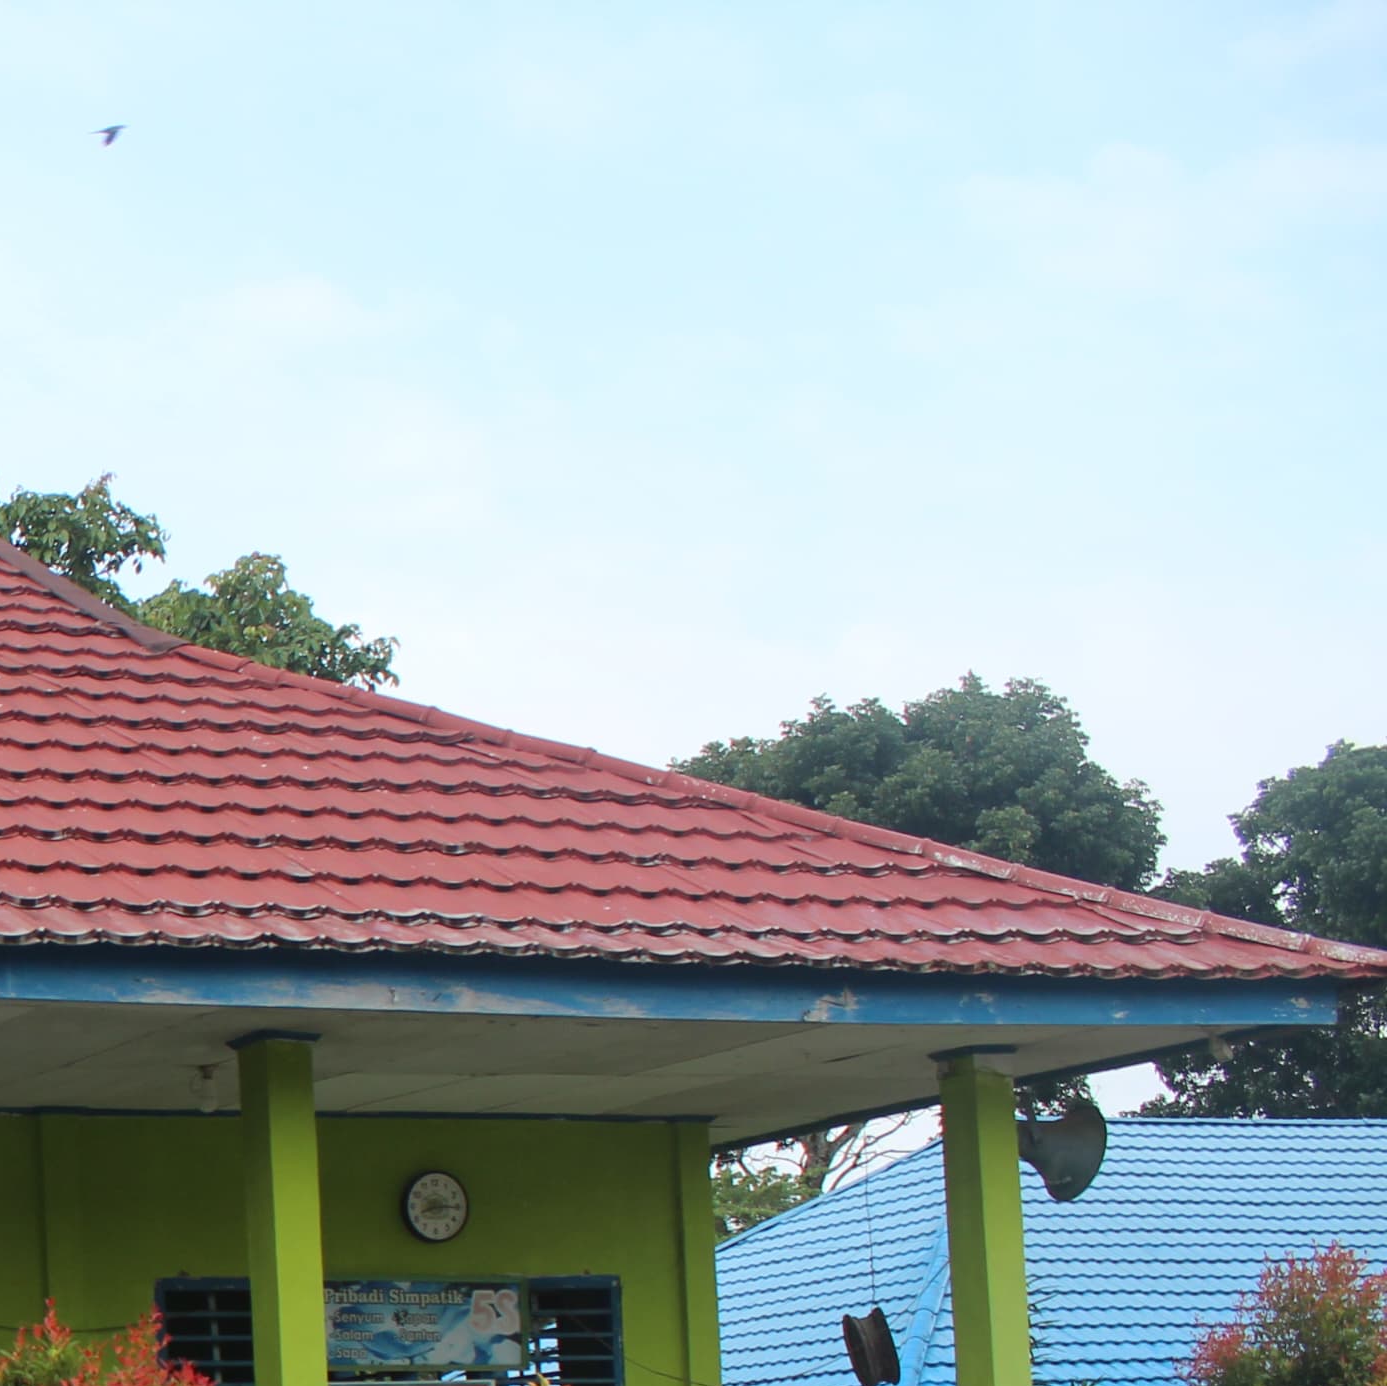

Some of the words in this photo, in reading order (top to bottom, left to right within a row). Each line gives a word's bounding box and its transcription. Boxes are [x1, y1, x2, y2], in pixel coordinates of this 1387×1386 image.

[324, 1288, 385, 1305] Pribadi
[388, 1288, 464, 1308] Simpatik
[471, 1289, 520, 1338] 5S
